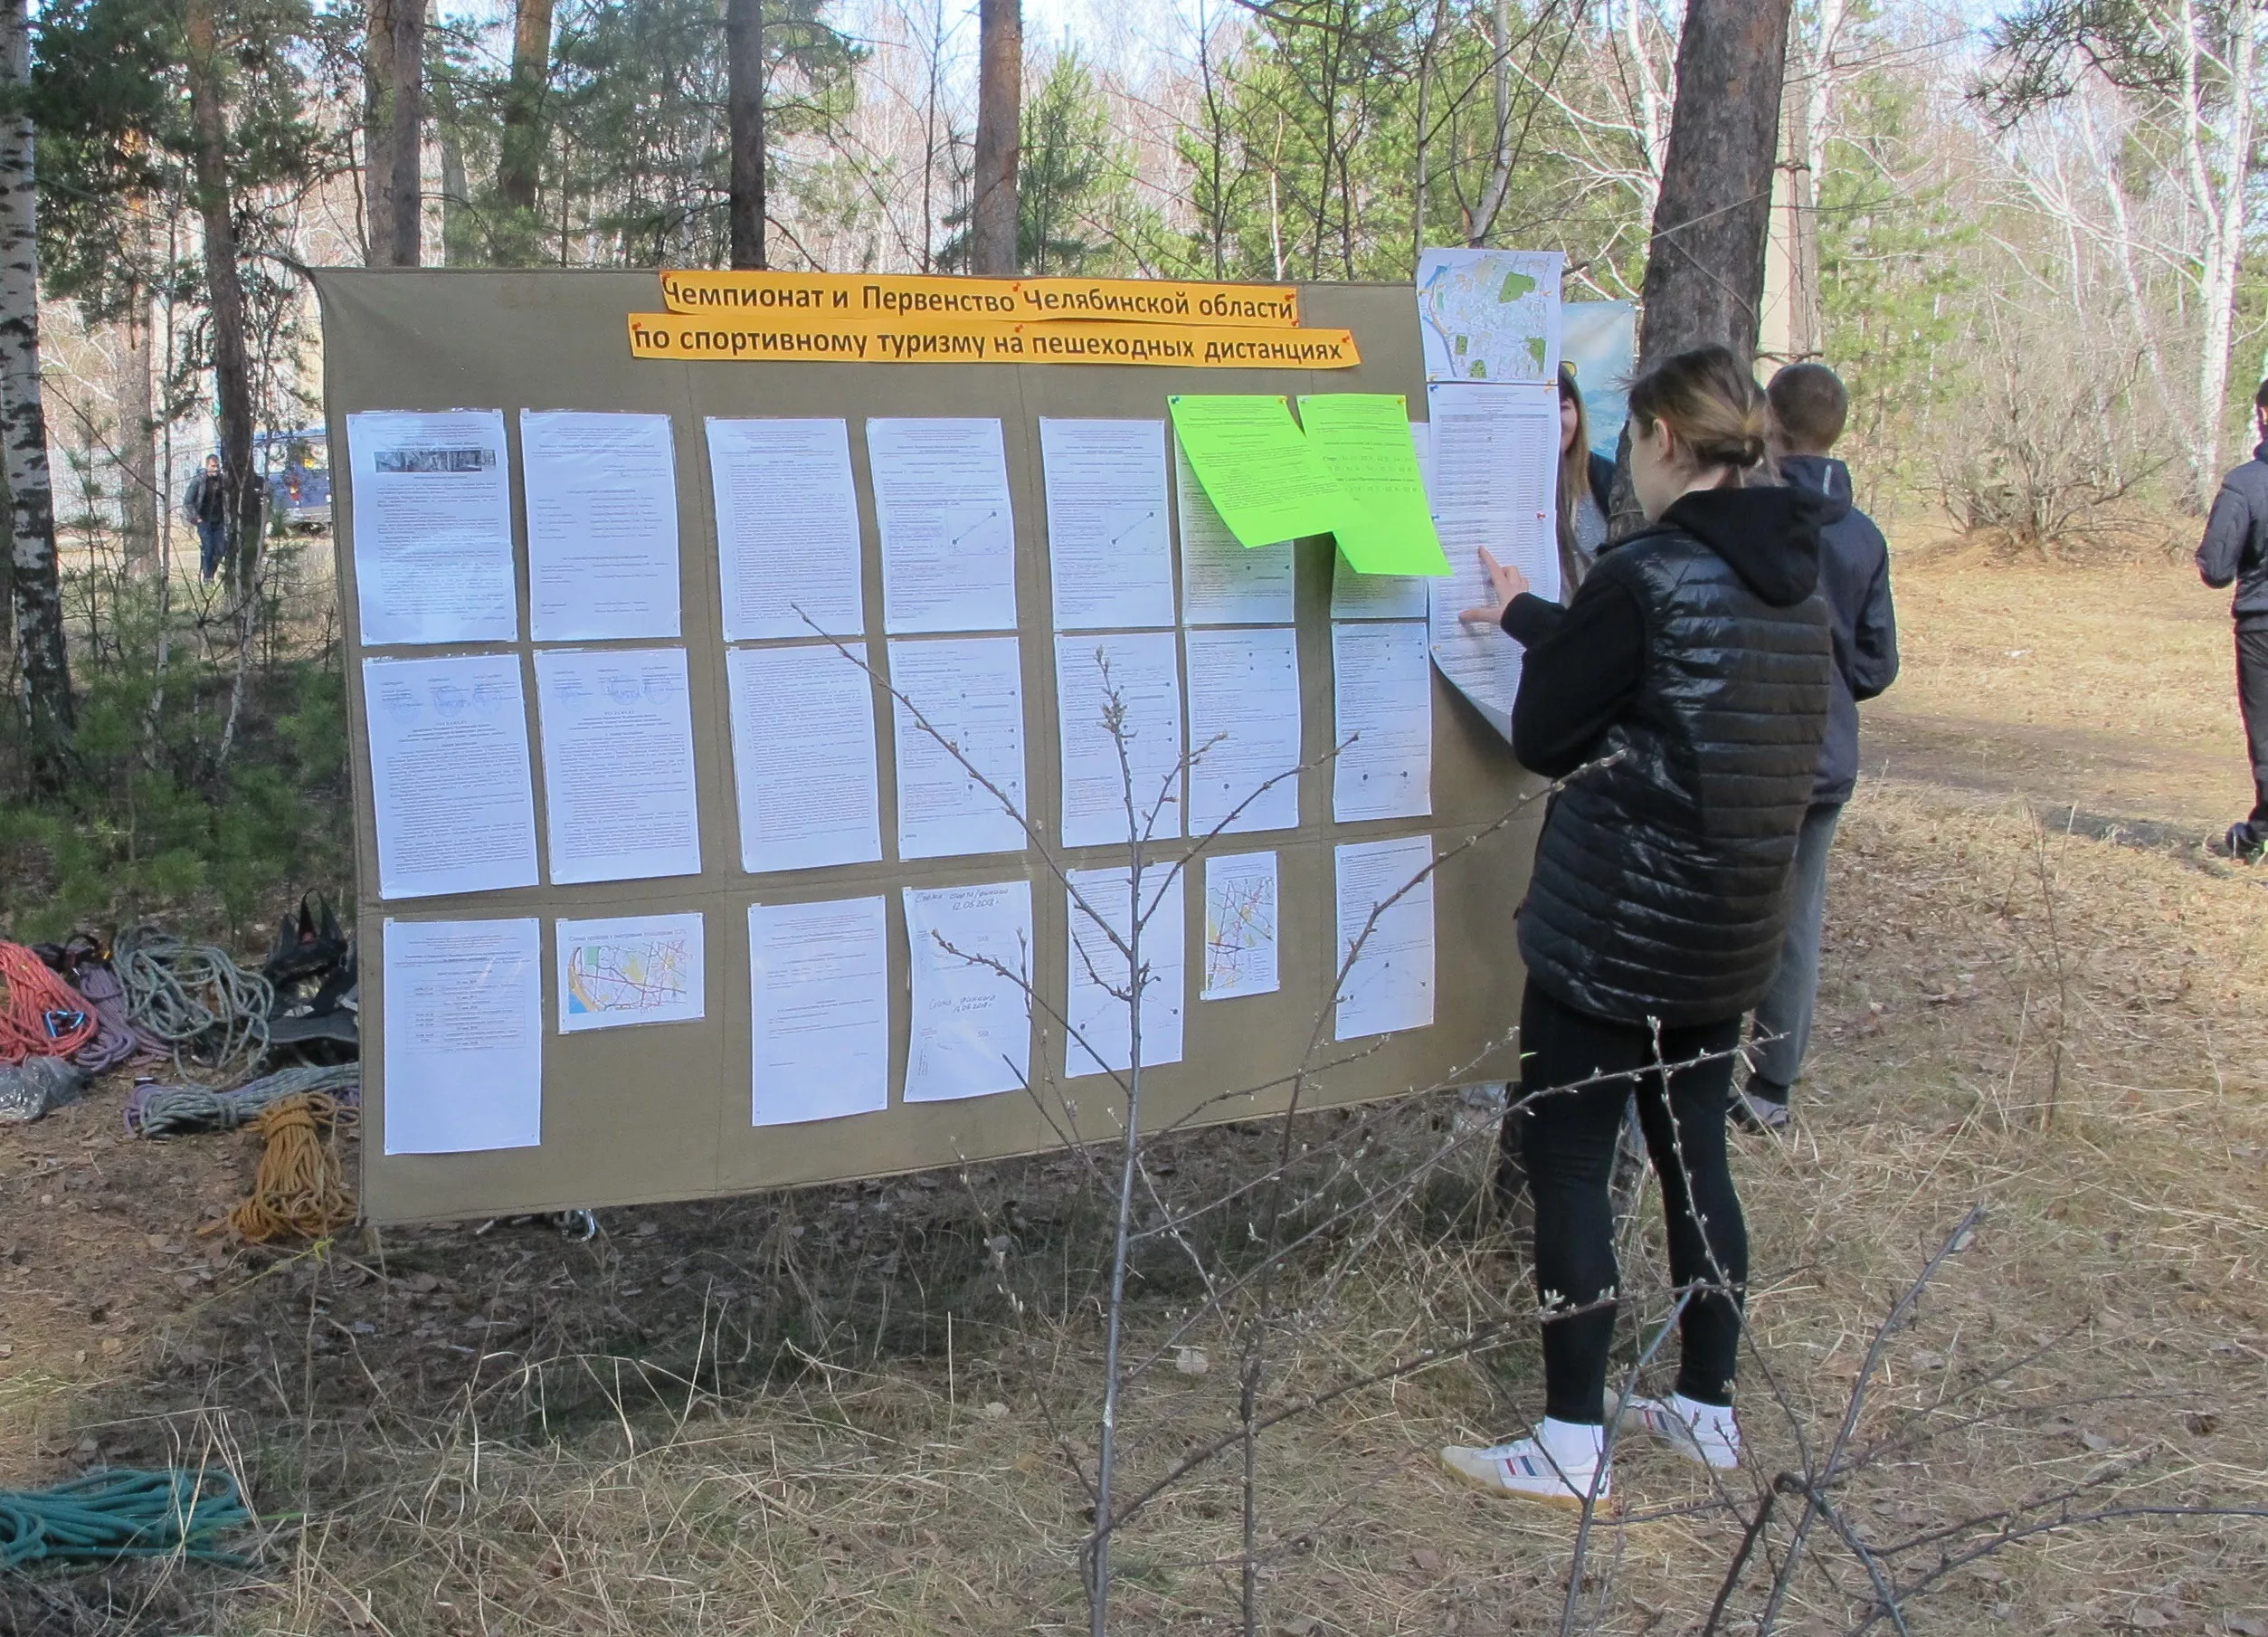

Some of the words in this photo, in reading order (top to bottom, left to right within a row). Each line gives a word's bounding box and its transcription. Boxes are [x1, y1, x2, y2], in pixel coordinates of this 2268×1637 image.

[663, 279, 824, 309] Чемпионат
[831, 289, 849, 309] и
[862, 285, 1015, 317] Первенство
[1023, 288, 1190, 316] Челябинской
[1199, 292, 1294, 319] области
[634, 329, 670, 349] по
[679, 330, 868, 358] спортивному
[876, 333, 986, 359] туризму
[993, 335, 1025, 355] на
[1031, 335, 1195, 360] пешеходных
[1204, 338, 1343, 364] дистанциях
